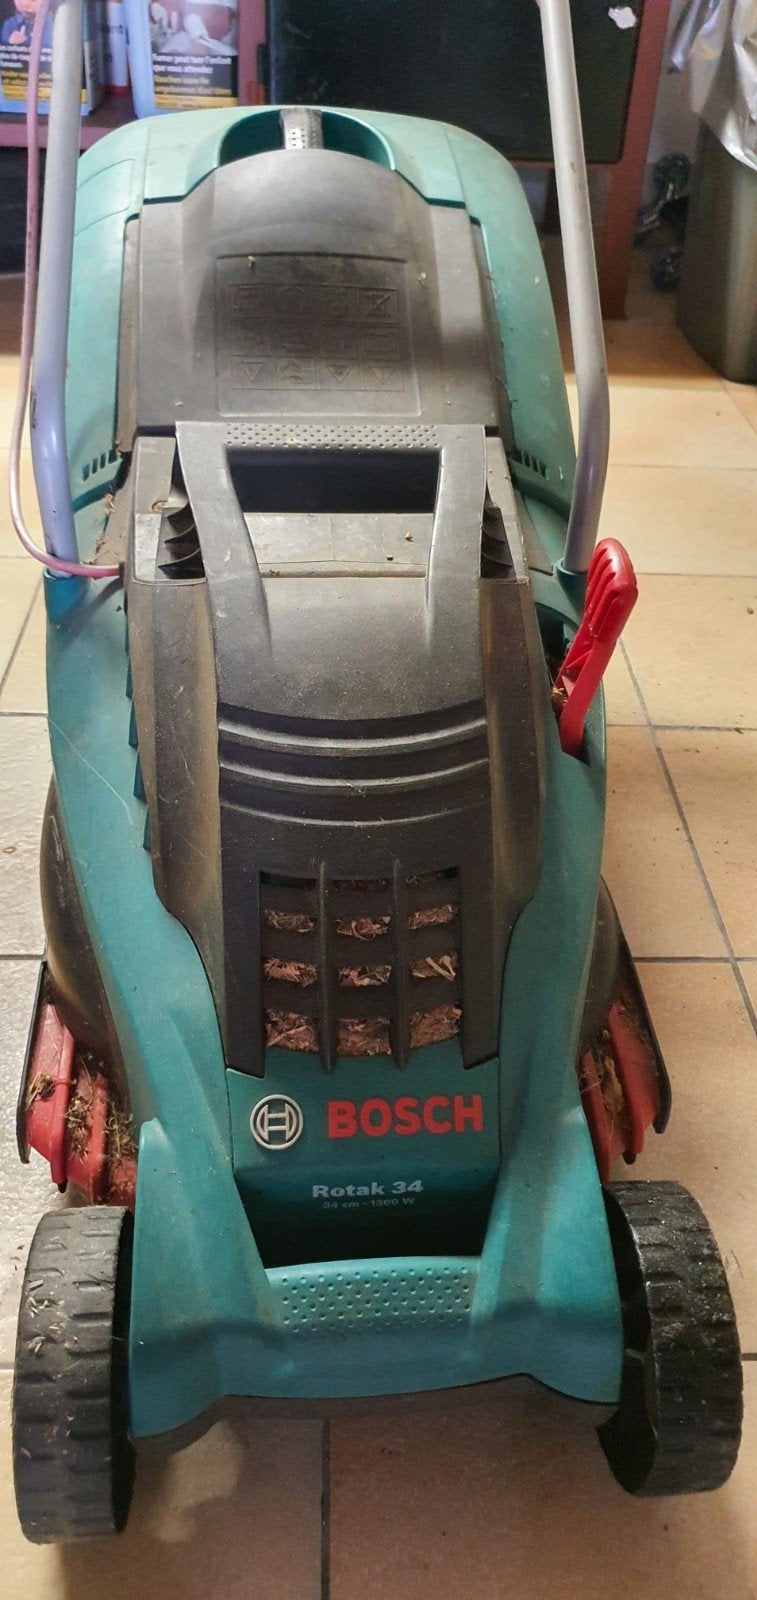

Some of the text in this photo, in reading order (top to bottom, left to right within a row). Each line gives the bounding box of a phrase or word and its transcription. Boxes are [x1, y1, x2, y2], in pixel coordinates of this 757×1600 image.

[327, 1095, 483, 1139] BOSCH
[312, 1179, 424, 1198] Rotak 34
[323, 1201, 339, 1209] 34
